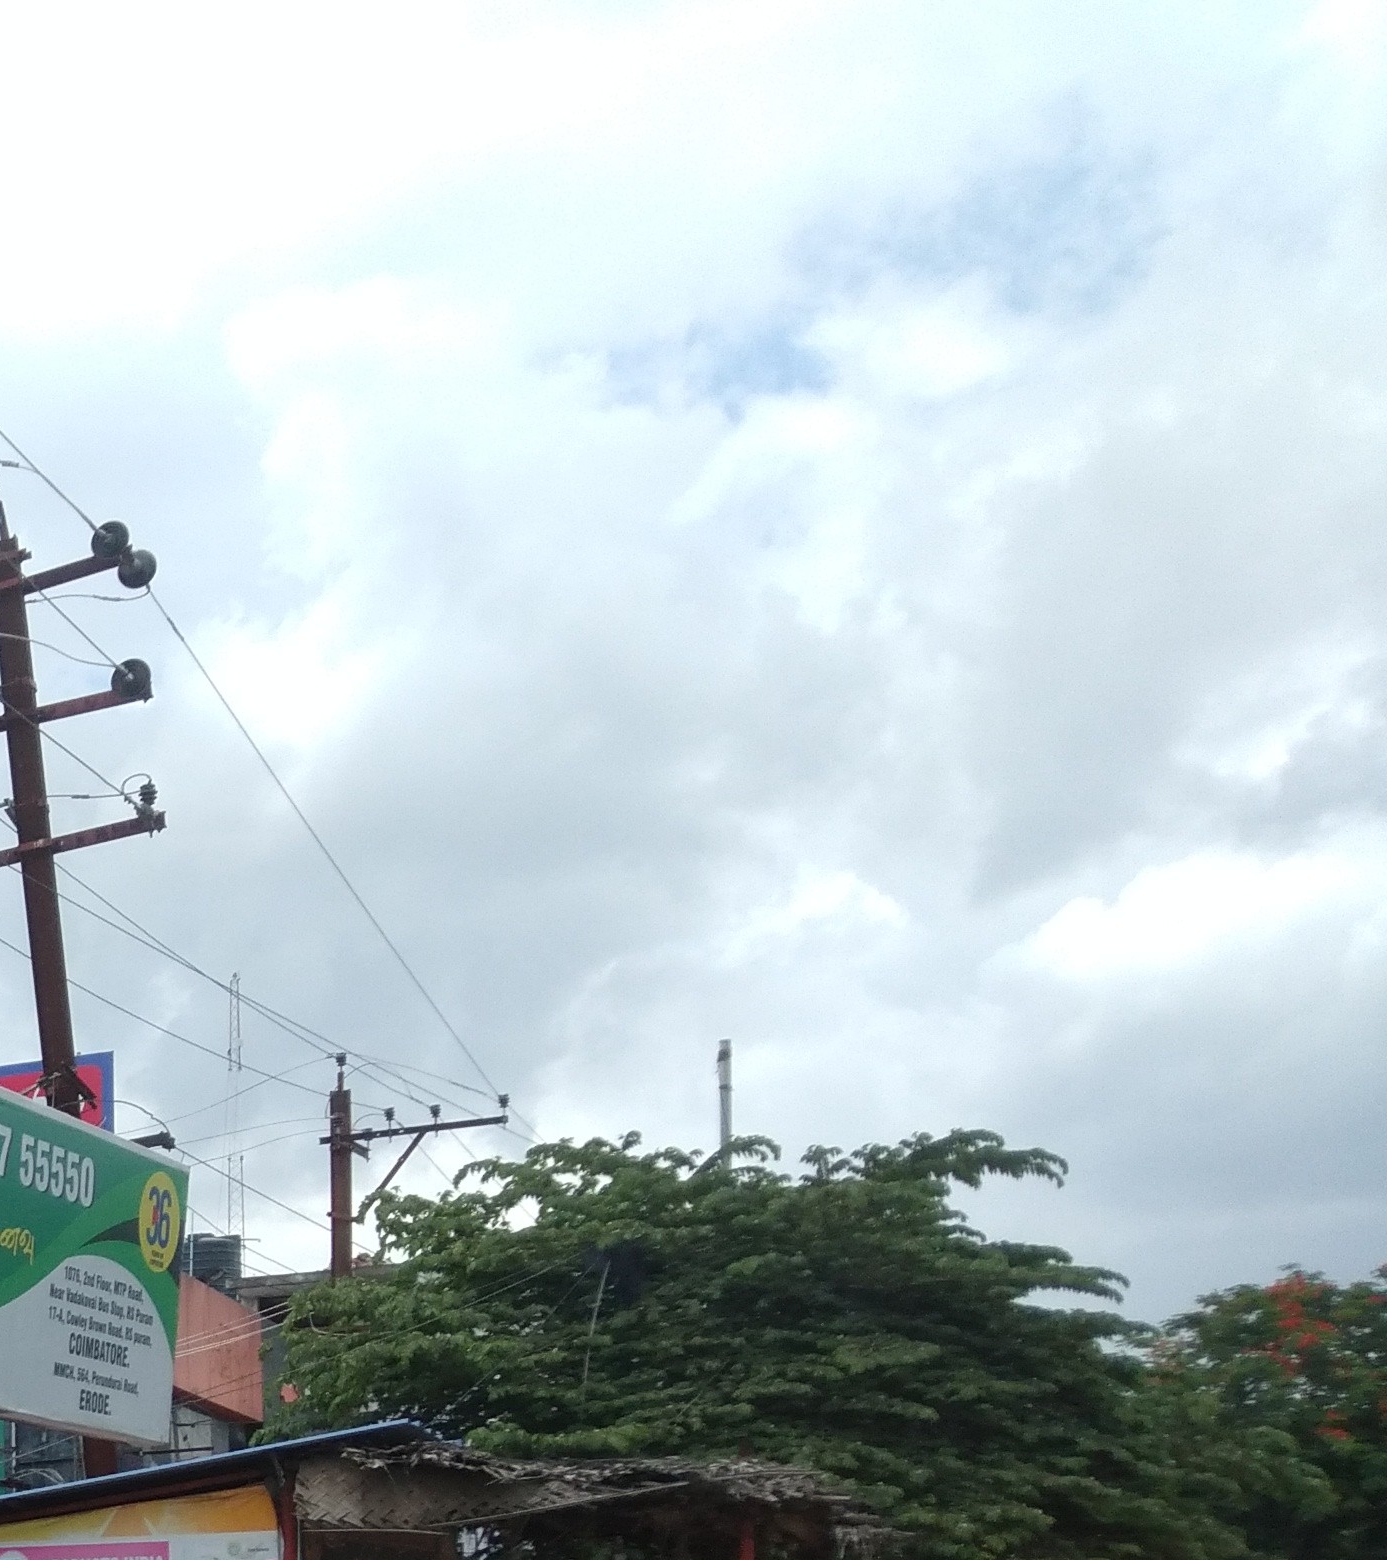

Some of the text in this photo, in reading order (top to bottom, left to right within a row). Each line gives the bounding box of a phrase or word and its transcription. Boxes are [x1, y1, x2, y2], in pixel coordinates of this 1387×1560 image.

[19, 1133, 95, 1209] 55550
[146, 1186, 173, 1249] 36
[83, 1271, 96, 1288] 2nd
[113, 1281, 128, 1296] MTP
[49, 1283, 65, 1300] Near
[98, 1295, 110, 1312] Bus
[126, 1305, 136, 1322] RS
[135, 1309, 154, 1326] Puram
[66, 1310, 88, 1331] Cowley
[88, 1316, 107, 1334] Brown
[124, 1326, 134, 1342] RS
[68, 1332, 131, 1369] COIMBATORE.
[79, 1388, 113, 1416] ERODE.
